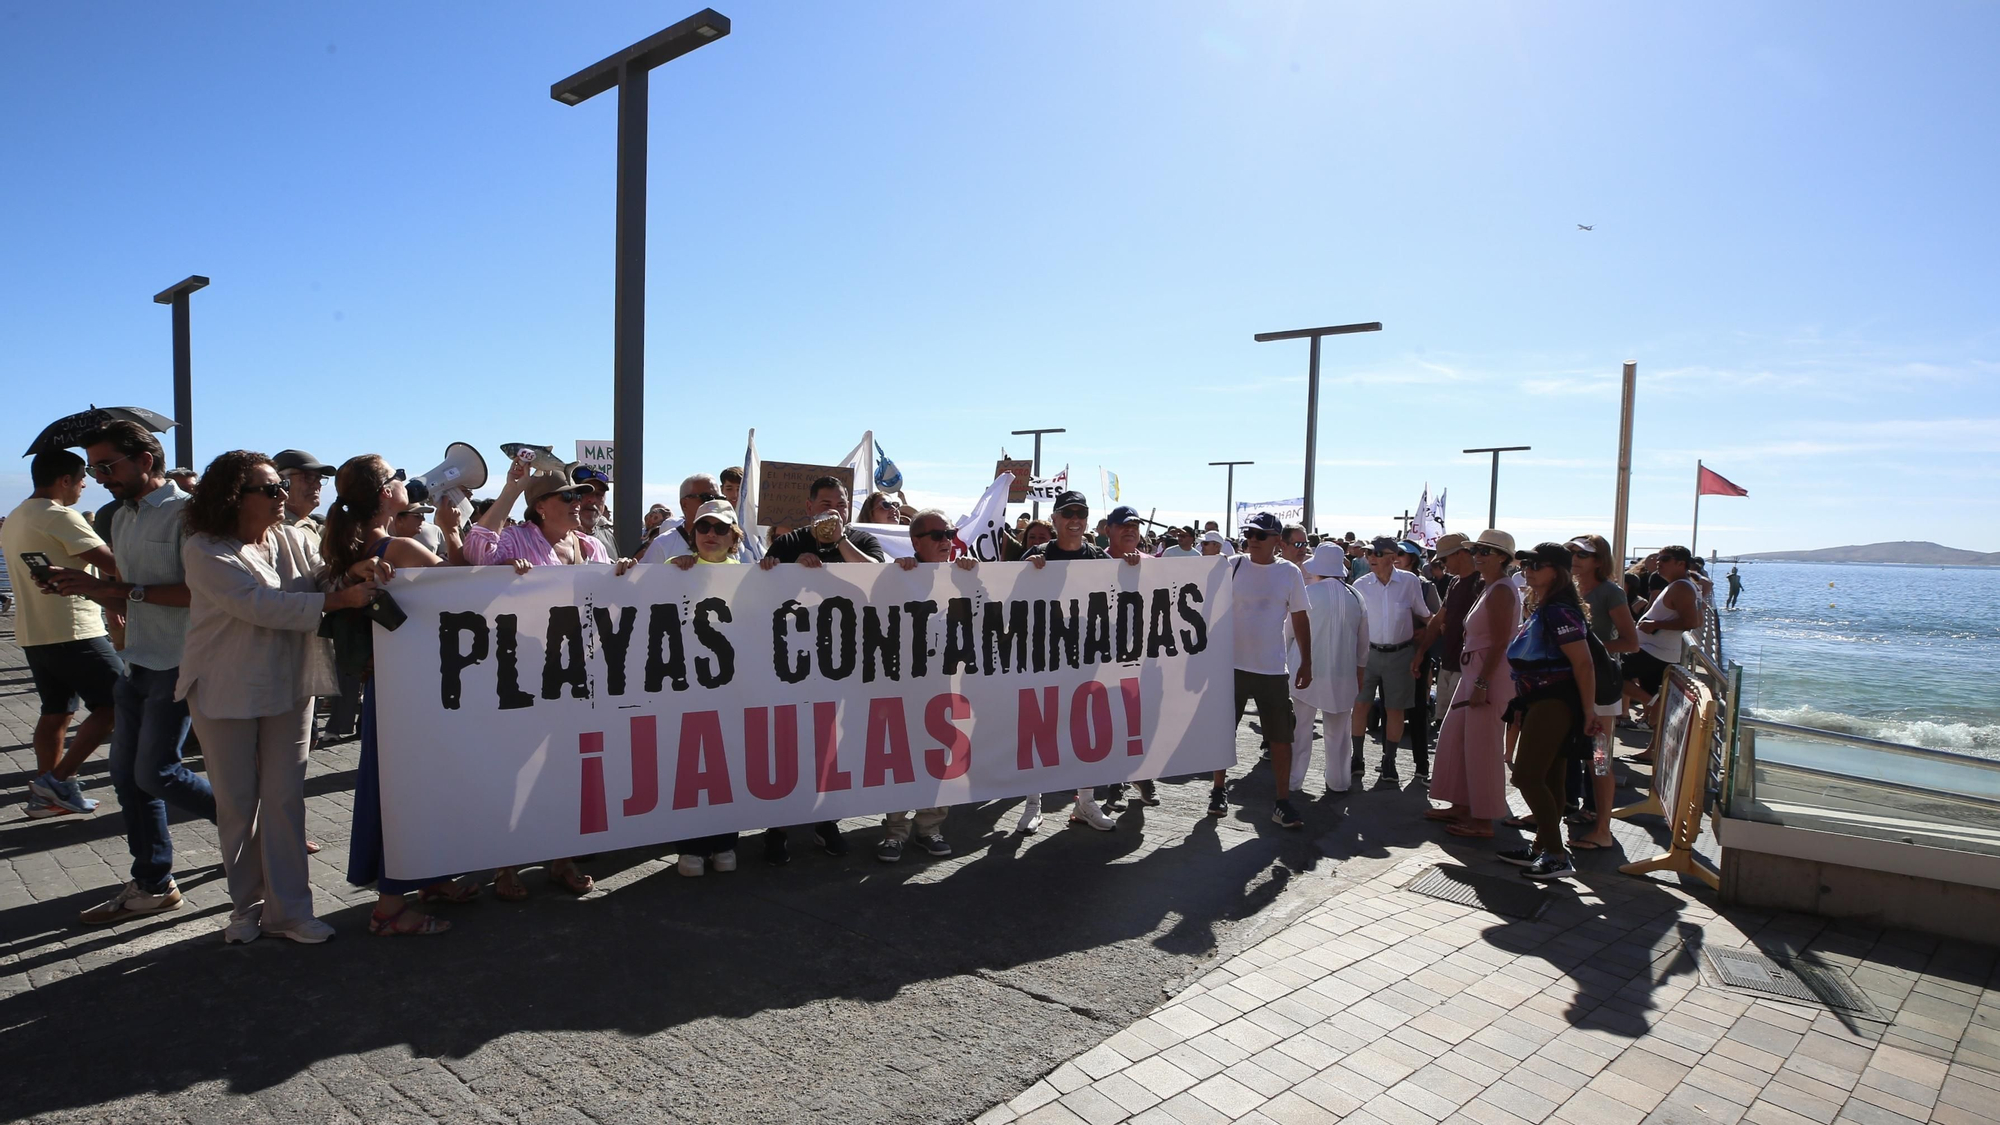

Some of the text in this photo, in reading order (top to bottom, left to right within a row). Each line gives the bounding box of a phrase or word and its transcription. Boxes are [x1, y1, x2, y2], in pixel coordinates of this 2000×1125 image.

[520, 450, 535, 461] SOS
[767, 471, 777, 479] EL
[783, 472, 803, 480] MAR
[439, 582, 1208, 711] PLAYAS CONTAMINADAS
[580, 677, 1144, 833] ¡JAULAS NO!
